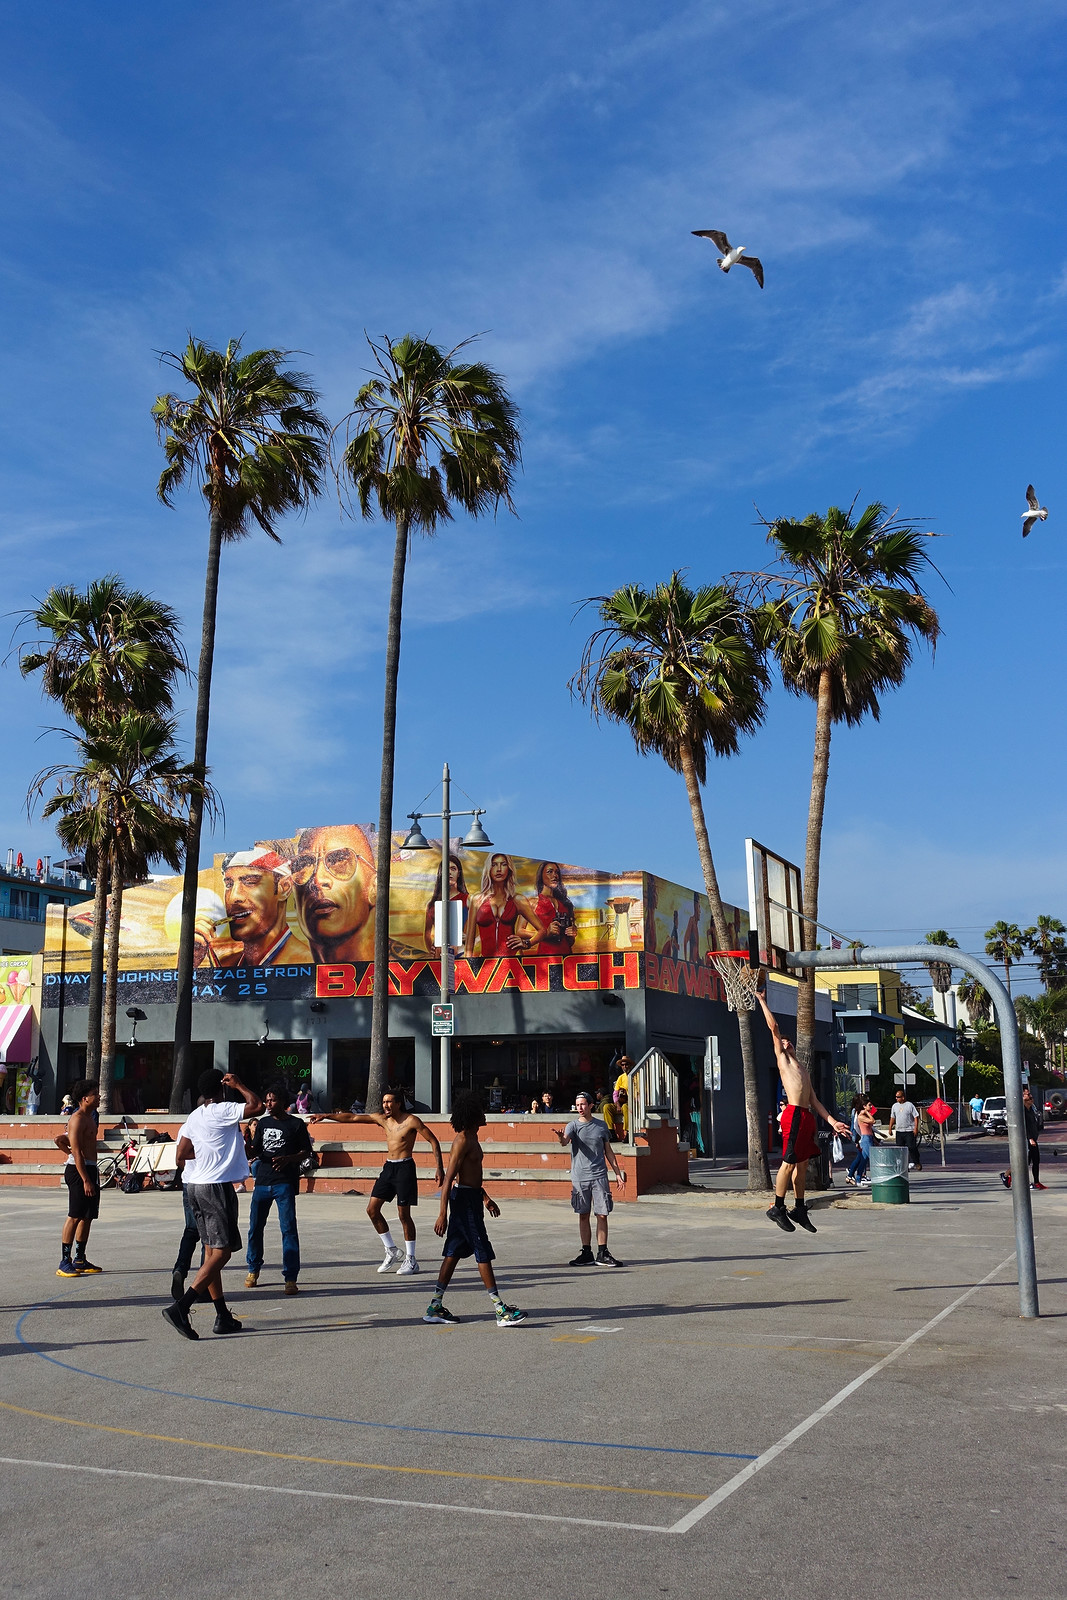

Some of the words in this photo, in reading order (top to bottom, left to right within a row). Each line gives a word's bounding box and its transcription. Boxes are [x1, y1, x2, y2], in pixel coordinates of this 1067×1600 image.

[213, 969, 247, 980] ZAC
[253, 967, 312, 978] EFRON
[315, 952, 640, 998] BAYWATCH
[238, 983, 268, 996] 25
